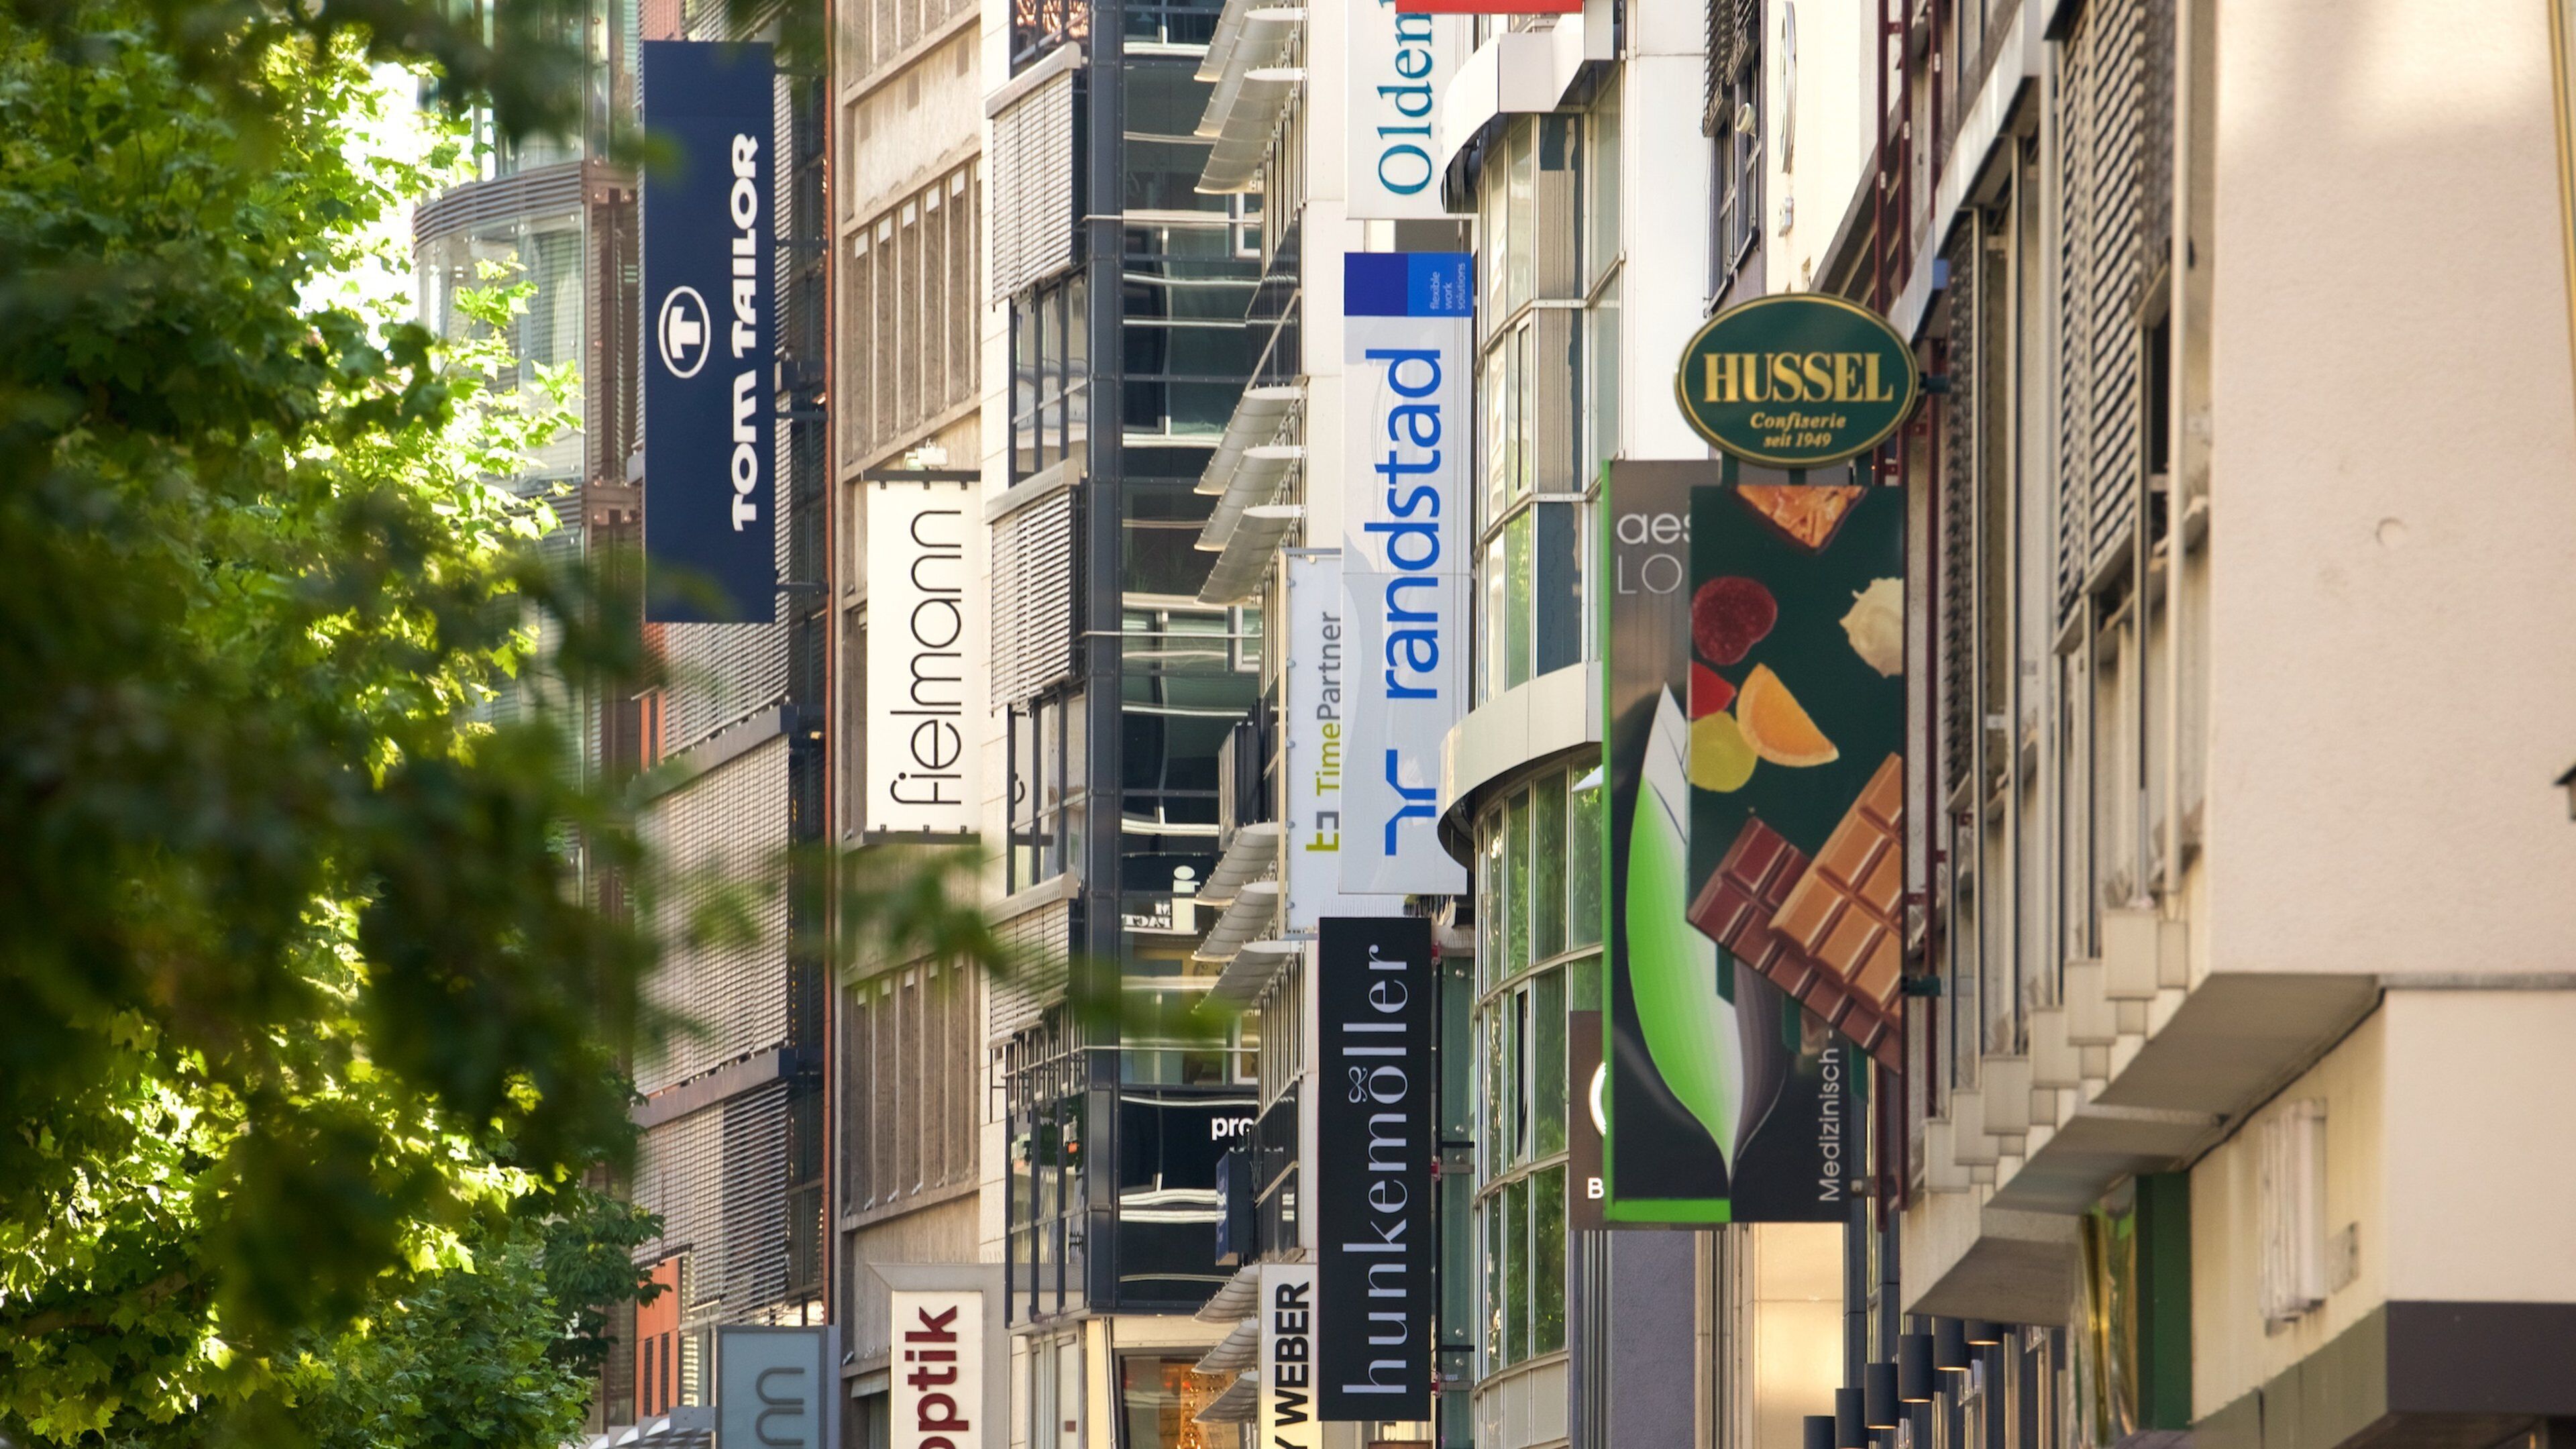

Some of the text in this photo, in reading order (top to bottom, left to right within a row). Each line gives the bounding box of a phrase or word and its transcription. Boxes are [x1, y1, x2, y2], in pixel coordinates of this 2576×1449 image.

[1377, 0, 1432, 195] Olden
[731, 133, 759, 531] TOM TAILOR
[1430, 271, 1440, 309] flexible
[1442, 282, 1452, 309] work
[1456, 262, 1466, 309] solutions
[1703, 351, 1894, 403] HUSSEL
[1750, 411, 1847, 433] Confiserie
[1764, 432, 1832, 448] seit 1949
[1364, 349, 1441, 700] randstad
[890, 510, 961, 805] fielmann
[1316, 611, 1341, 796] TimePartner
[1819, 1048, 1840, 1201] Medizinisch
[1275, 1281, 1309, 1428] WEBER
